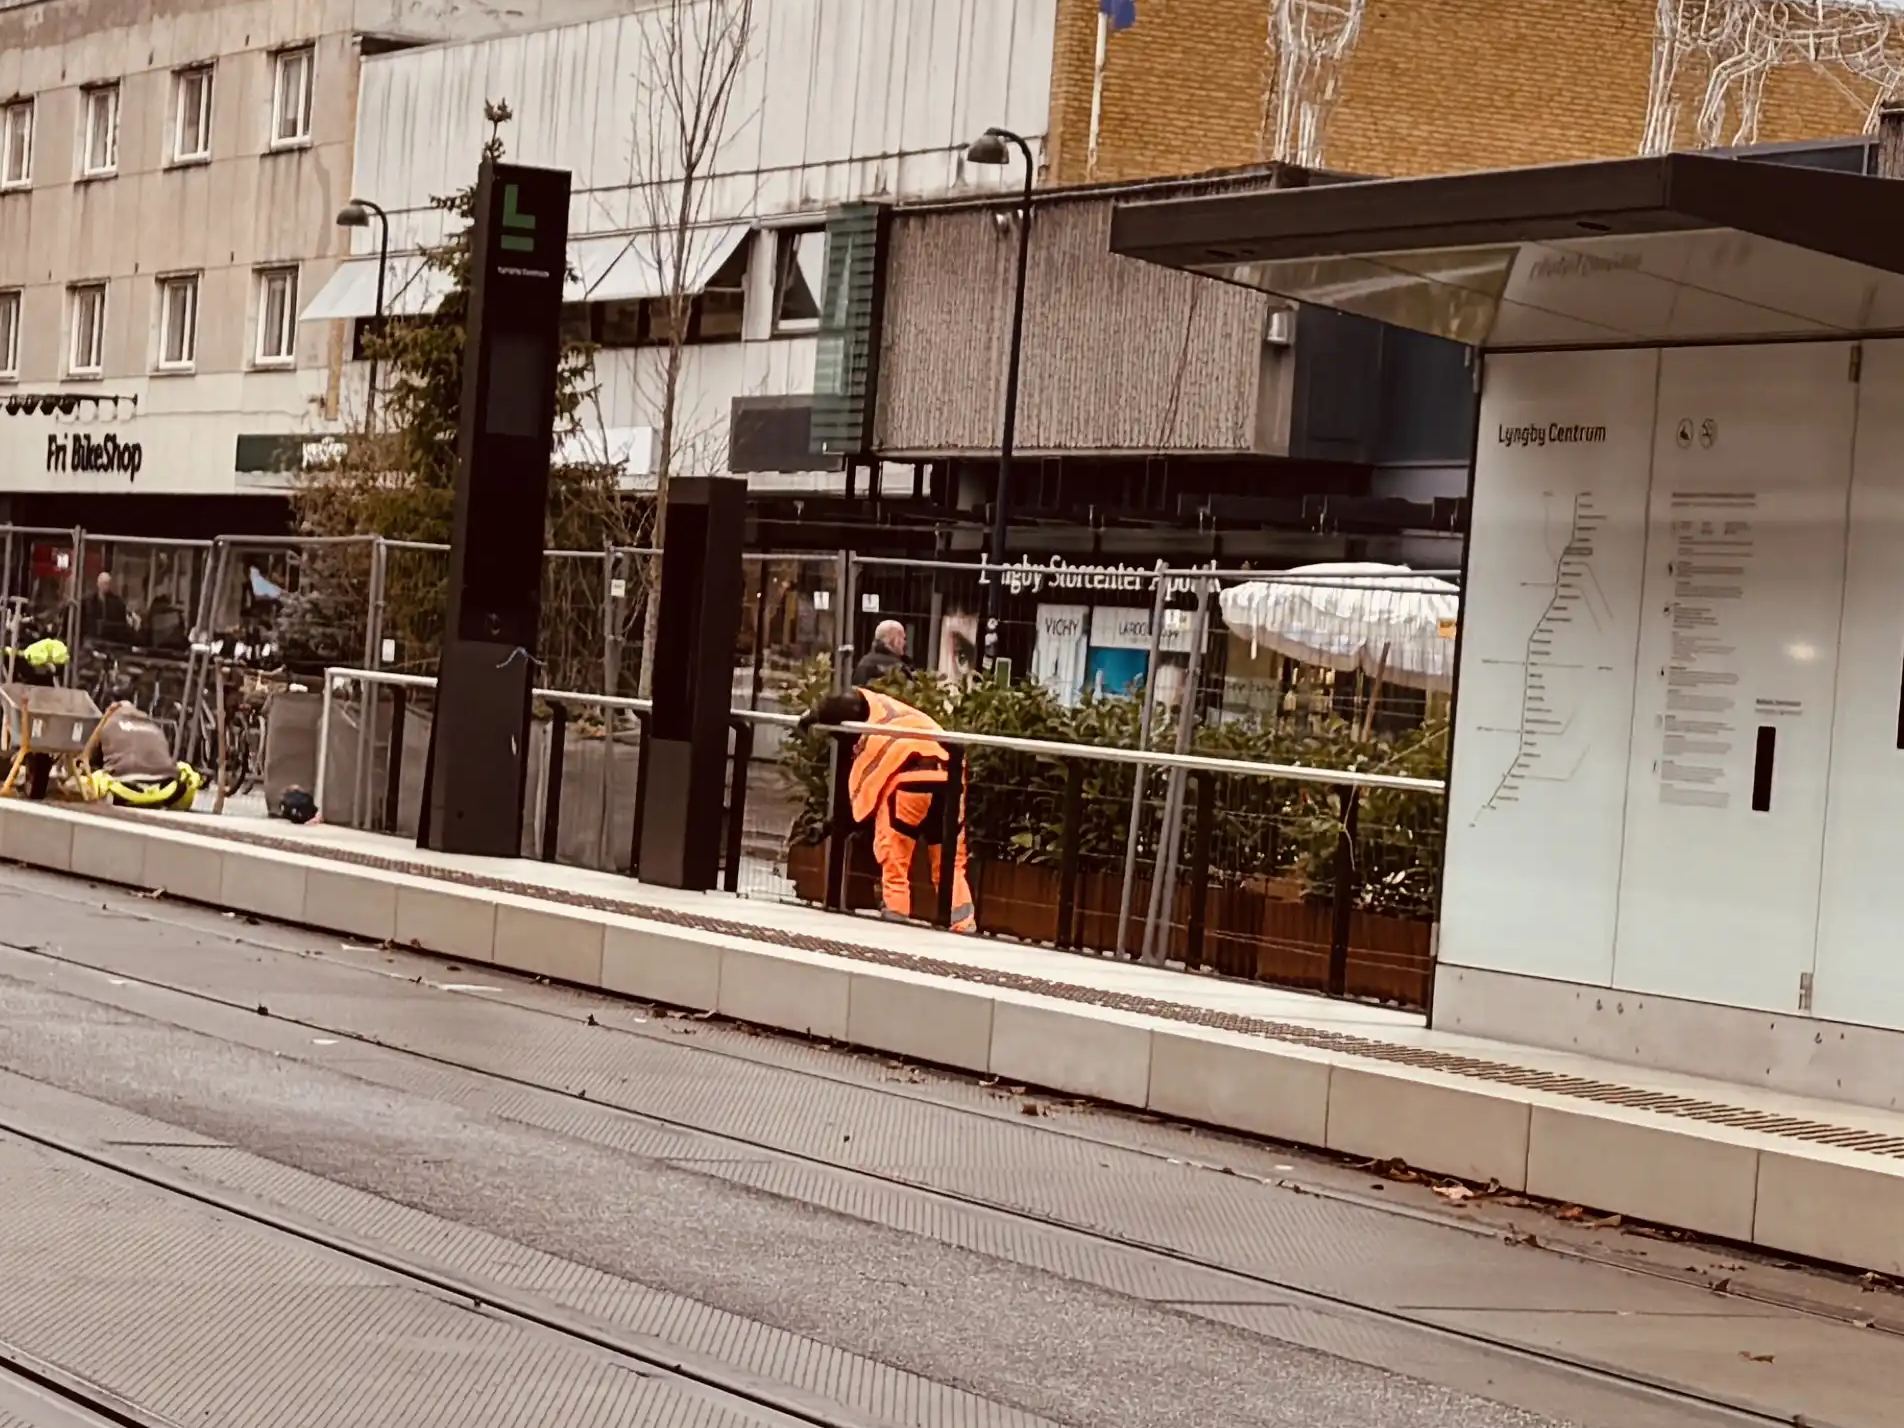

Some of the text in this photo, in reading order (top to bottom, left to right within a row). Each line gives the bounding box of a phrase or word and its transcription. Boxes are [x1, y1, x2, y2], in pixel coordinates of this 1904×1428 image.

[1498, 422, 1607, 447] Lyngby Centrum
[47, 432, 142, 484] Fri BikeShop
[978, 553, 1045, 595] Lngby
[1048, 554, 1145, 590] Storcenter
[1046, 618, 1079, 636] VICHY
